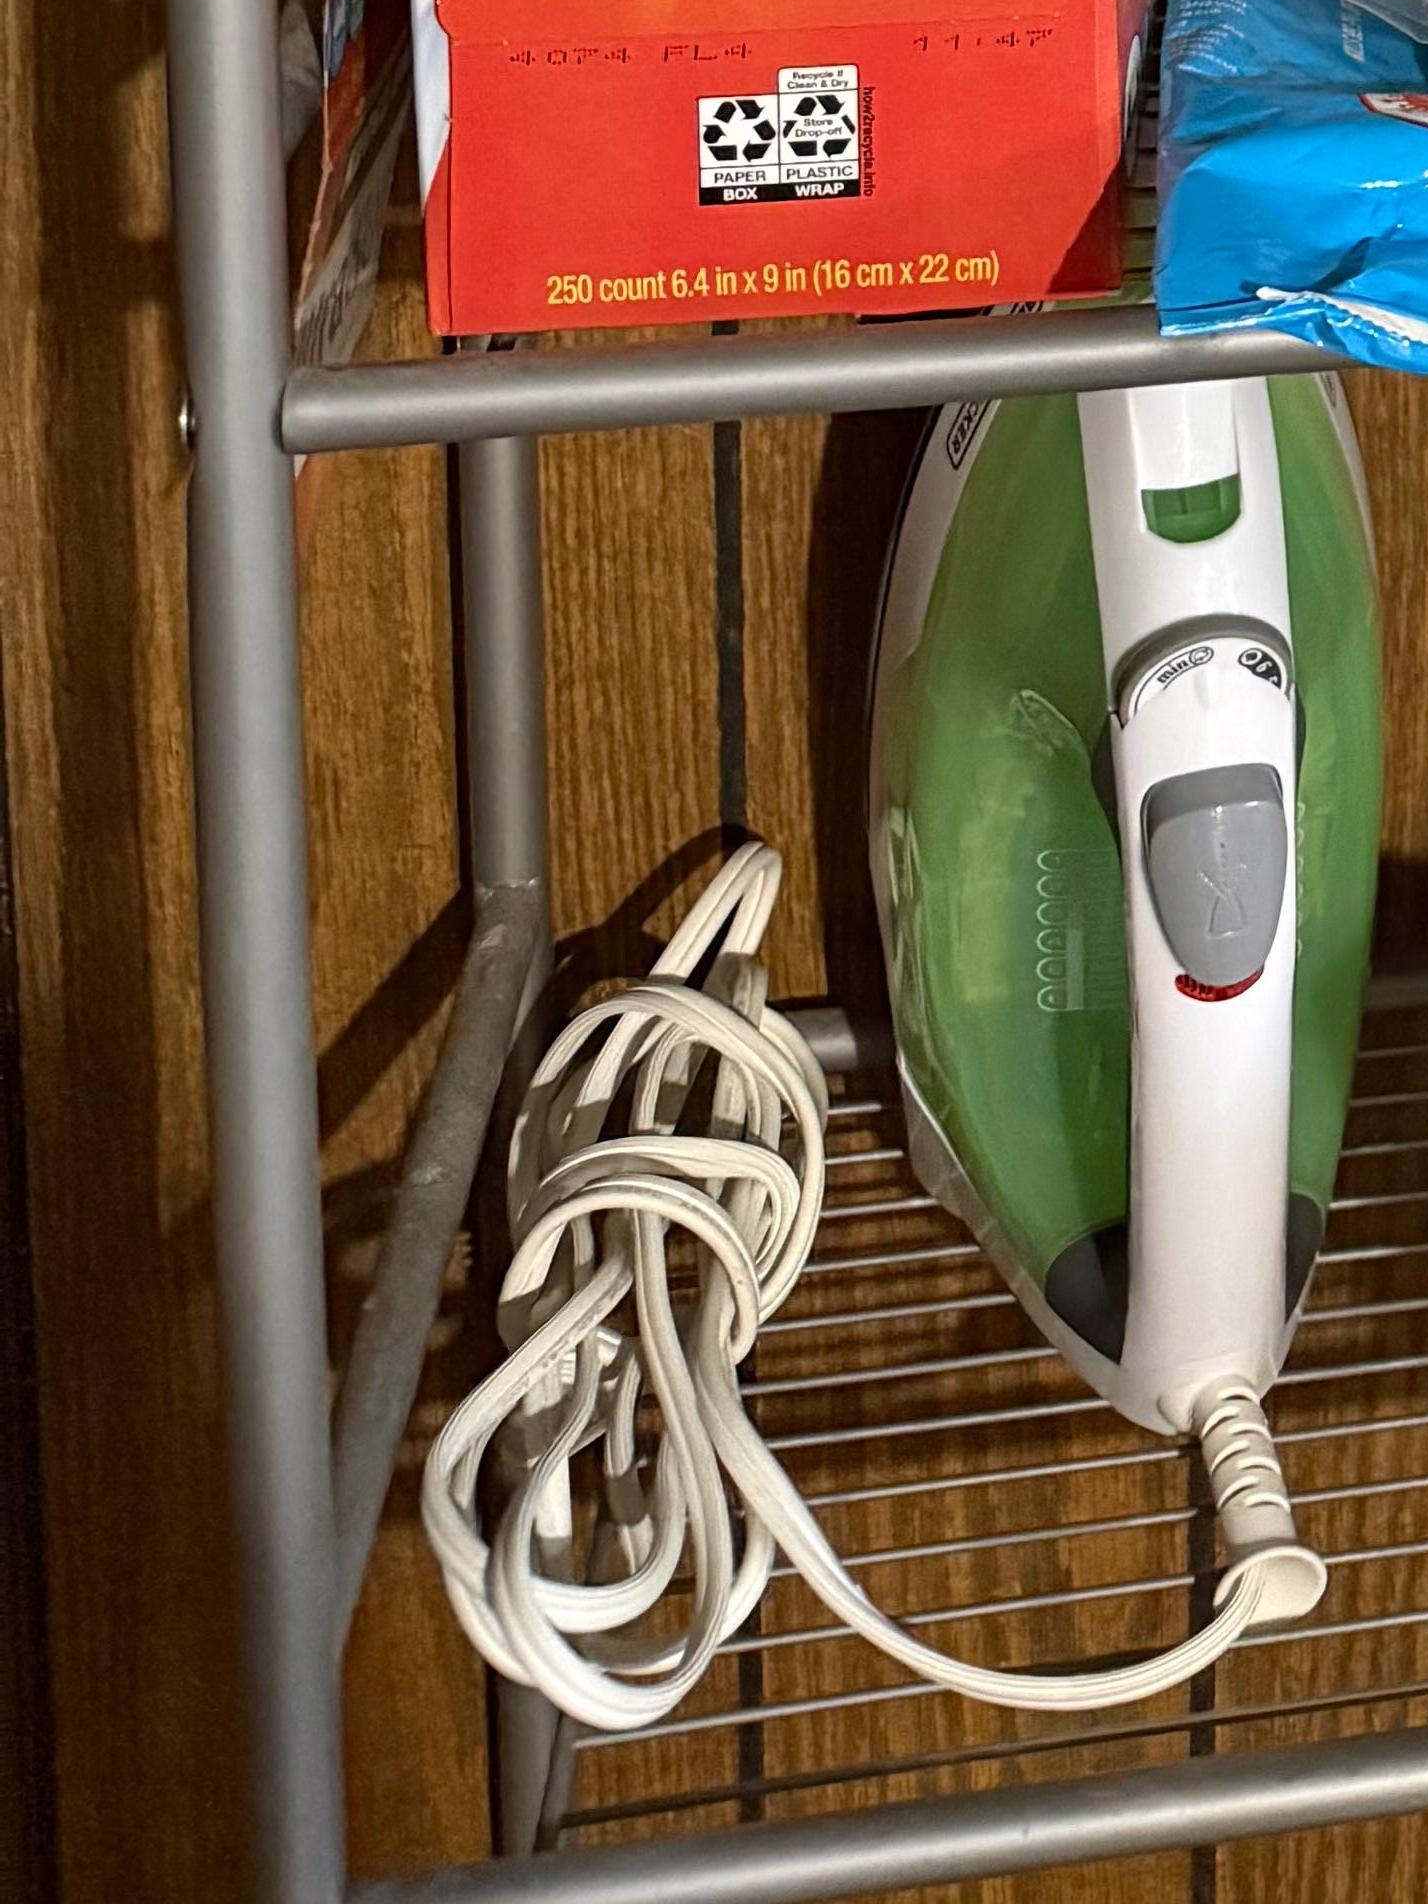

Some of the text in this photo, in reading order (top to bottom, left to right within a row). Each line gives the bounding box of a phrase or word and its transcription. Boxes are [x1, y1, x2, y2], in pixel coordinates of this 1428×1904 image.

[787, 78, 848, 90] Clean & Dry
[803, 118, 834, 127] Store
[795, 127, 843, 138] Drop-off
[714, 170, 767, 184] PAPER
[786, 165, 853, 180] PLASTIC
[723, 187, 758, 201] BOX
[795, 182, 845, 197] WRAP
[547, 250, 999, 304] 250 count 6.4 in x 9 in (16 cm x 22 cm)
[1156, 659, 1188, 685] min
